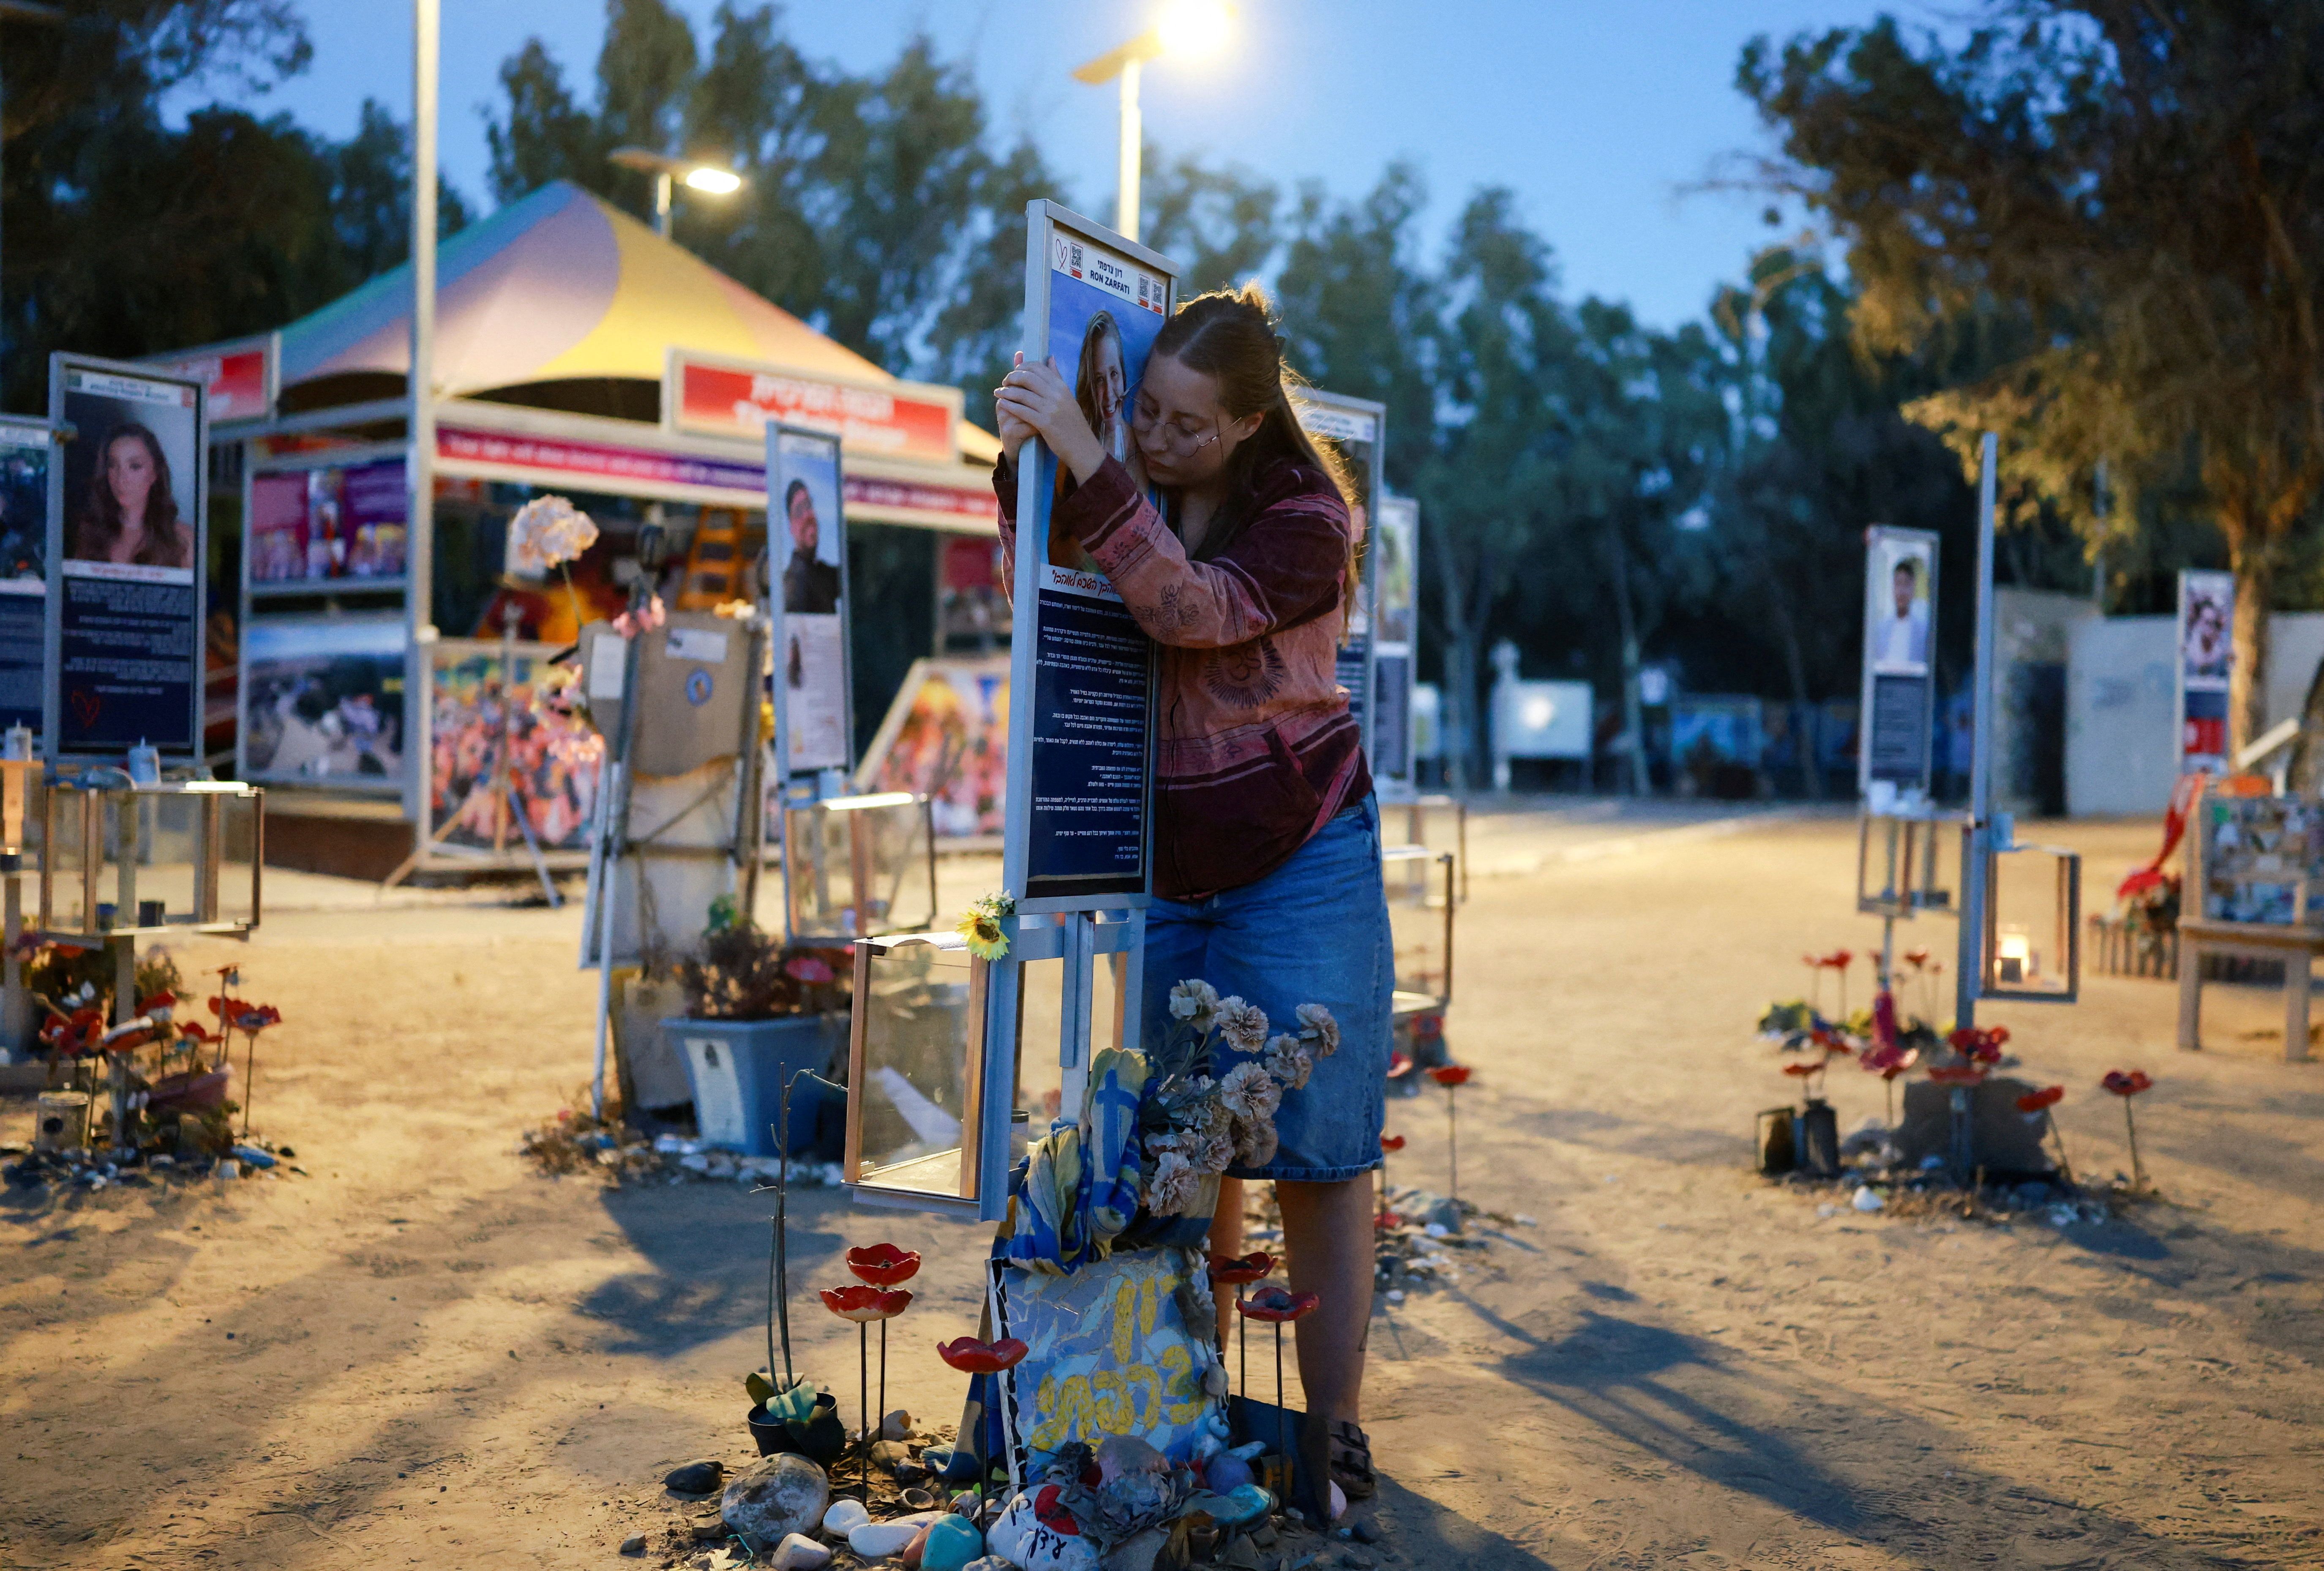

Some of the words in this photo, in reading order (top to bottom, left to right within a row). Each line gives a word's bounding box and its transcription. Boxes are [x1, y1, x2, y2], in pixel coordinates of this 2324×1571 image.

[1098, 260, 1113, 274] צרפתי
[1090, 270, 1103, 283] RON
[1105, 277, 1129, 294] ZARFATI
[1077, 577, 1097, 590] השכם
